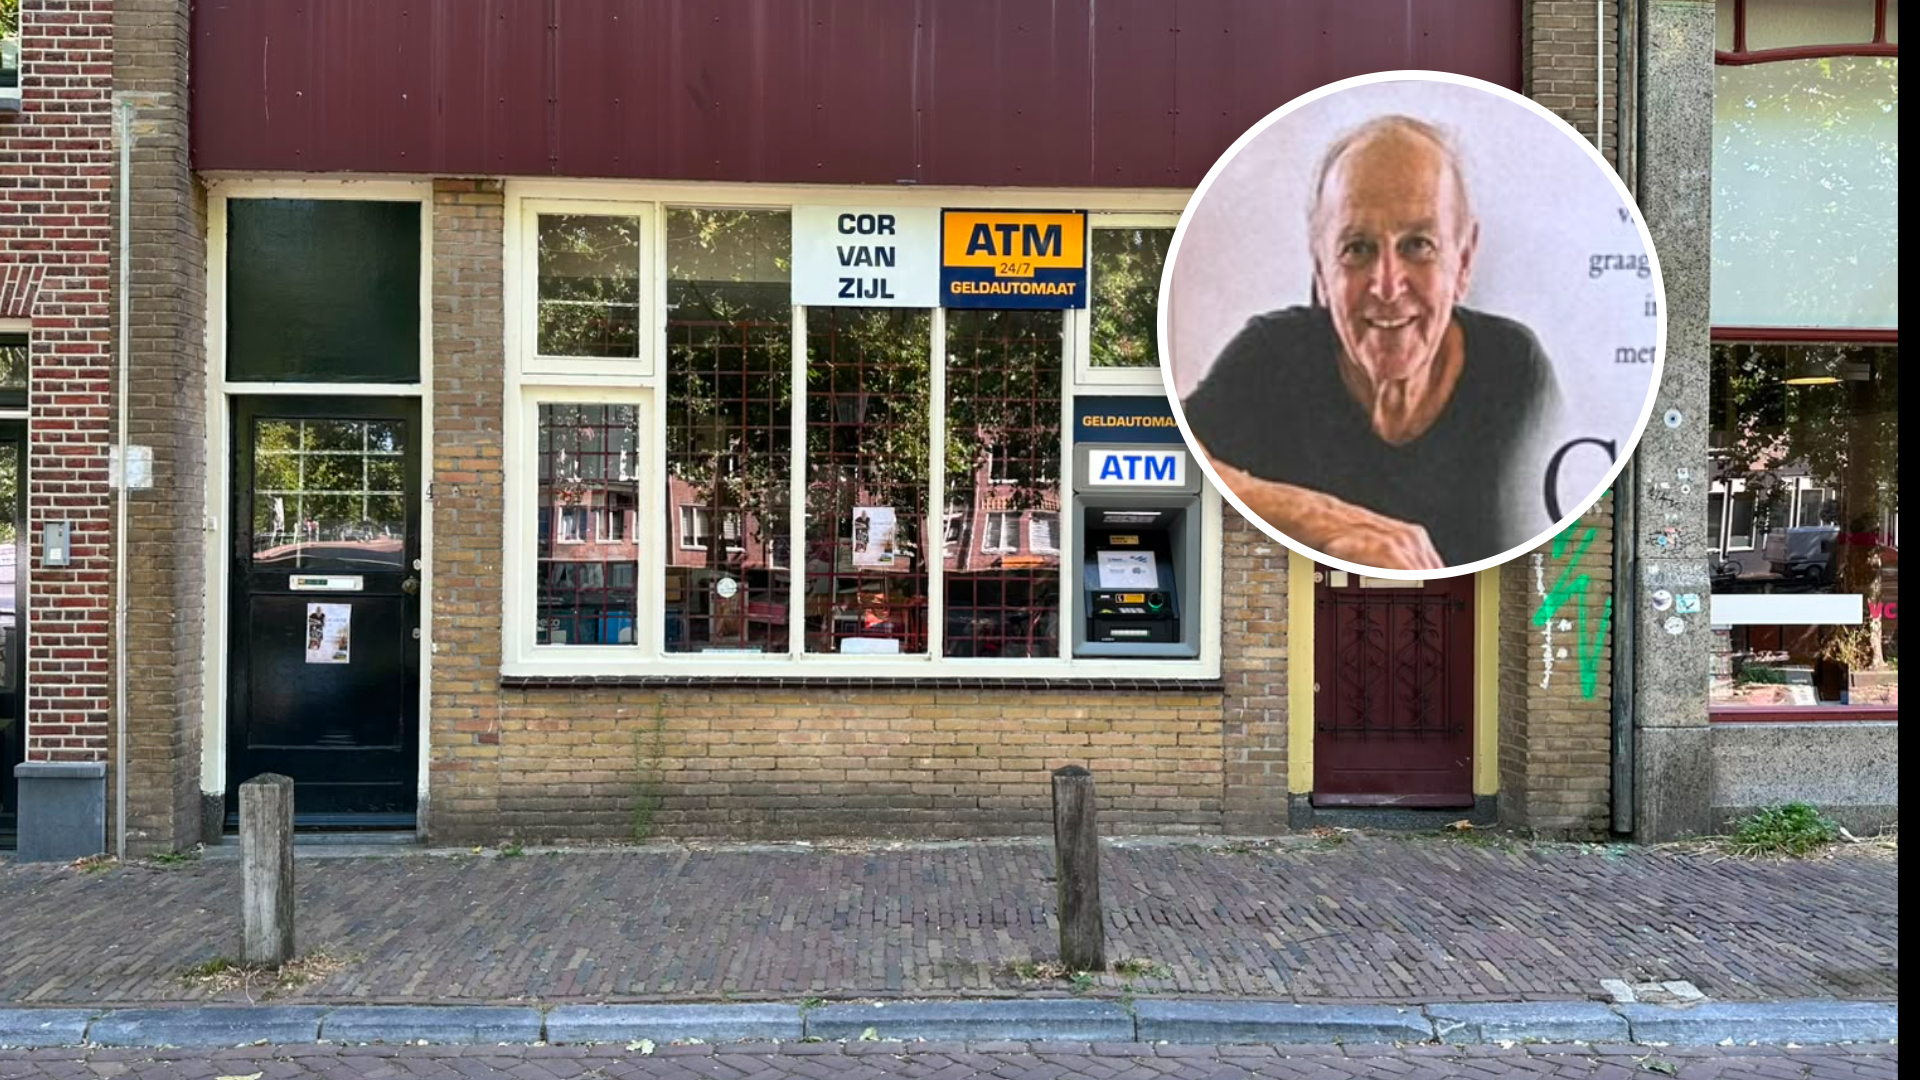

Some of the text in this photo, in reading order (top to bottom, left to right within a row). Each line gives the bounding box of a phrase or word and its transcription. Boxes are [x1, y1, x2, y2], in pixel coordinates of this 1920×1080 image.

[838, 213, 896, 235] COR
[965, 223, 1062, 257] ATM
[836, 245, 896, 267] VAN
[1000, 262, 1031, 274] 24/7
[838, 277, 895, 299] ZIJL
[950, 281, 1077, 295] GELDAUTOMAAT
[1099, 454, 1176, 481] ATM
